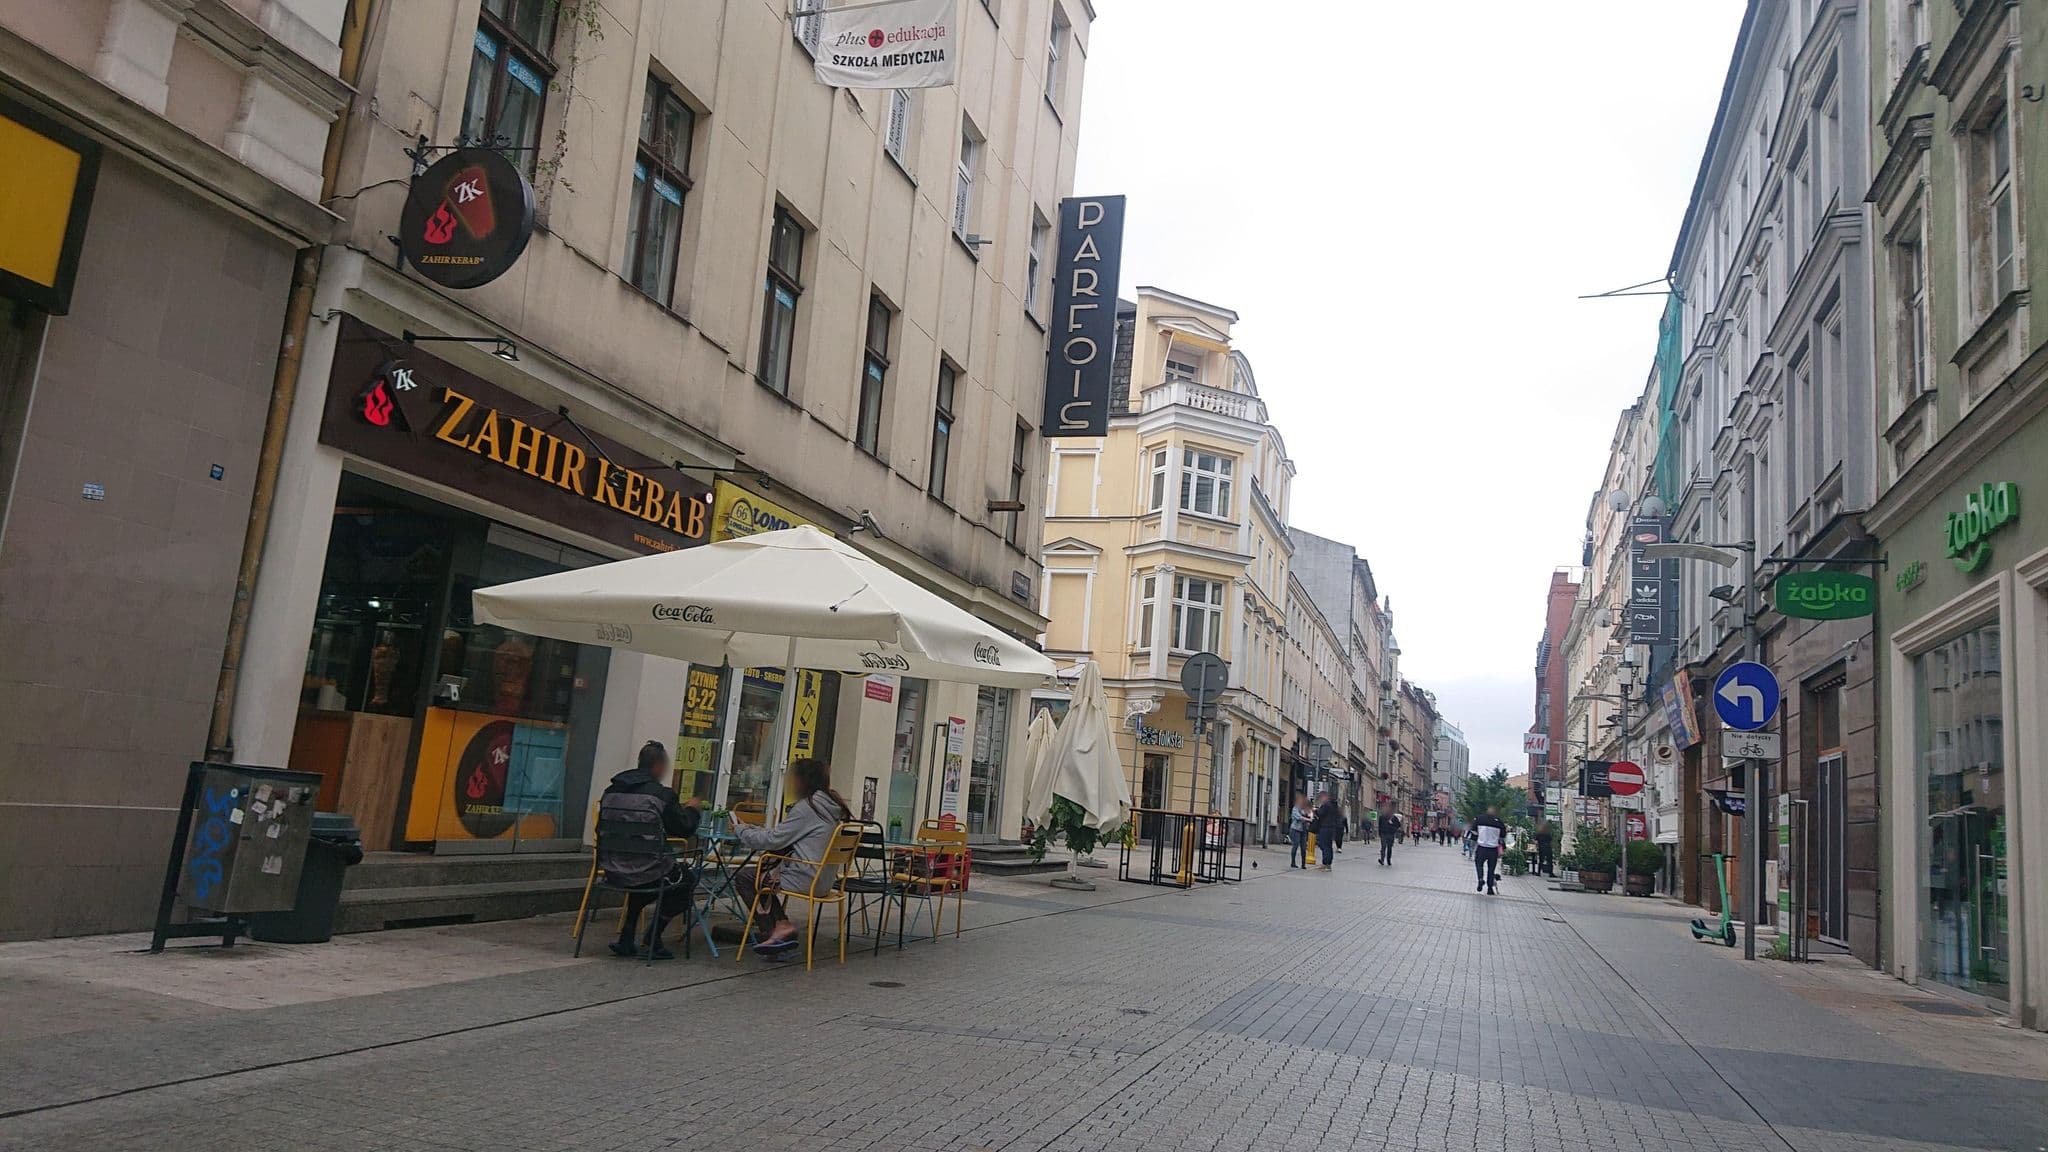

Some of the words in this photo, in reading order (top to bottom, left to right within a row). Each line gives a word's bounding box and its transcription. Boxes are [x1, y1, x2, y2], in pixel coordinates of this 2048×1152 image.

[835, 31, 867, 47] plus
[887, 22, 946, 44] edukacja
[832, 54, 878, 67] SZKOŁA
[882, 49, 945, 67] MEDYCZNA
[454, 178, 485, 204] ZK
[421, 255, 451, 264] ZAHIR
[1059, 201, 1105, 430] PARFOIS
[392, 368, 418, 391] ZK
[435, 386, 586, 496] ZAHIR
[592, 456, 706, 540] KEBAB
[753, 508, 797, 531] LOMB
[1944, 481, 2017, 559] żabka
[1787, 582, 1866, 602] żabka
[652, 603, 714, 624] Coca-Cola
[974, 641, 1001, 666] Coca-Cola
[687, 686, 716, 711] 9-22
